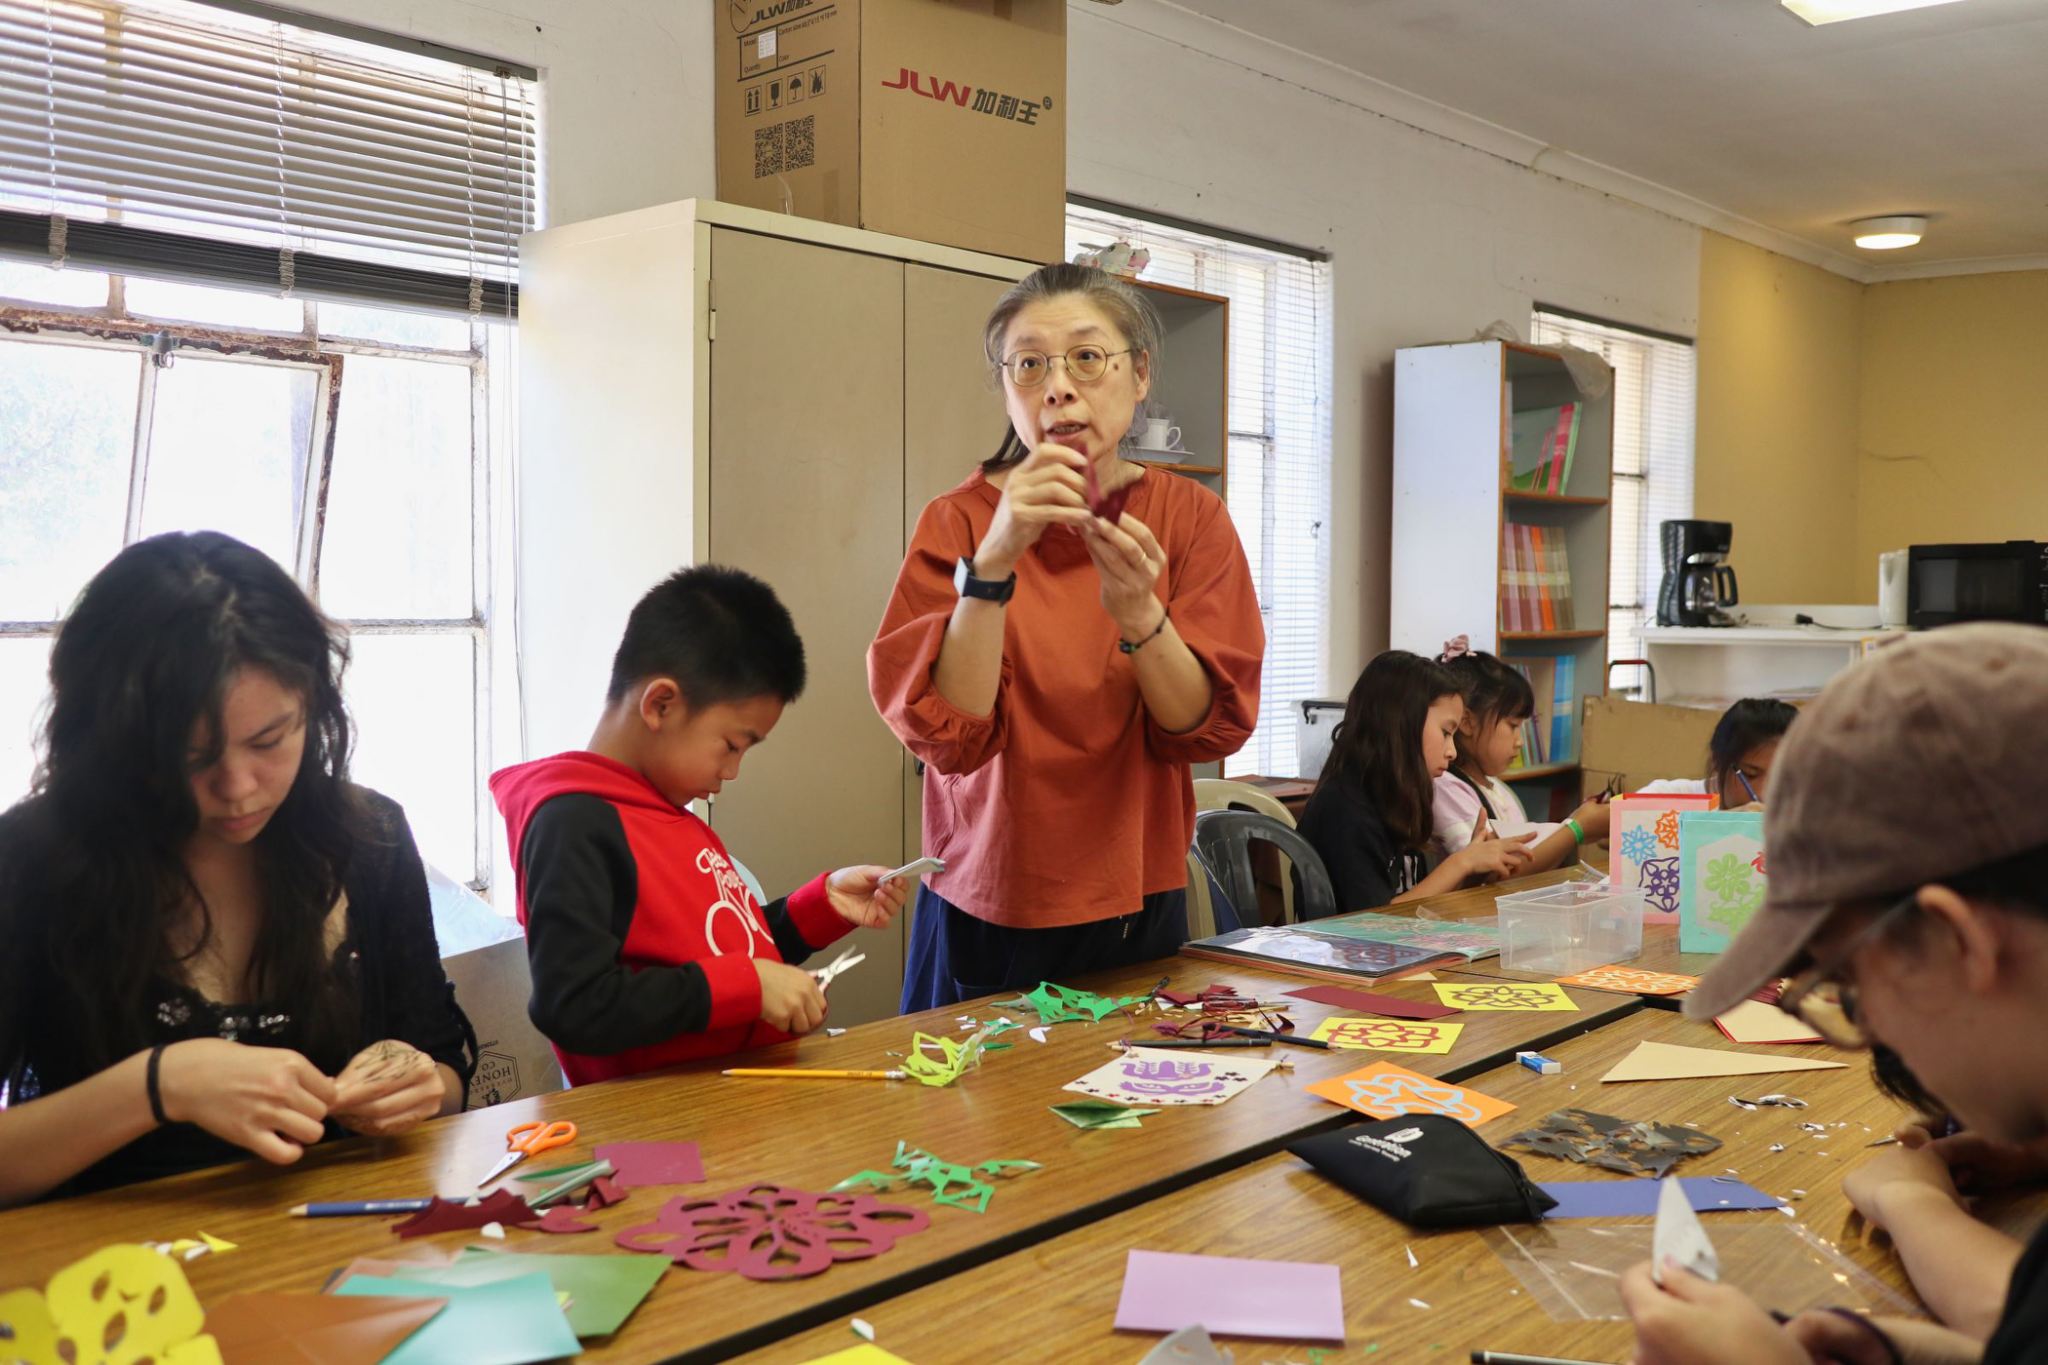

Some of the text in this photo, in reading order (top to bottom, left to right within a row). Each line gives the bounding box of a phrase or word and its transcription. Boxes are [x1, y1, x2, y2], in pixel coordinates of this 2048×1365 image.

[750, 2, 786, 25] JLW
[881, 67, 1041, 126] JLW 加利王
